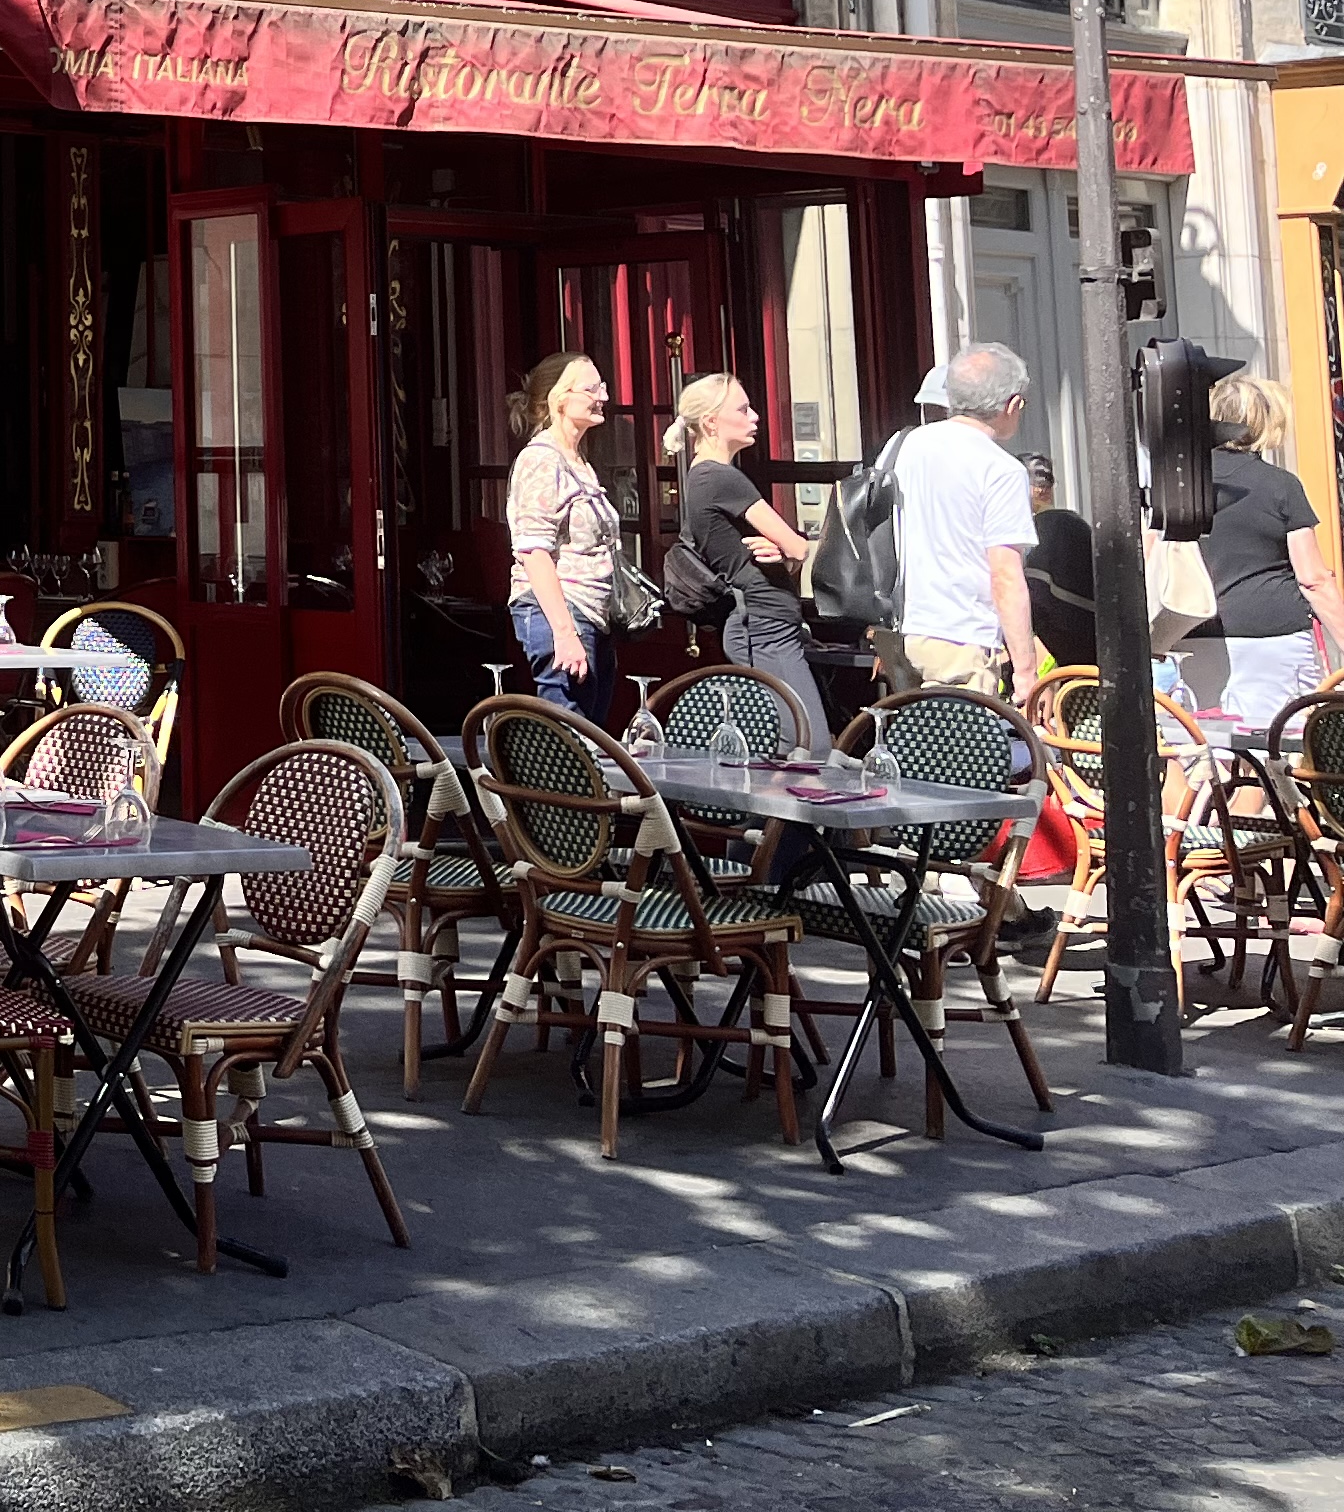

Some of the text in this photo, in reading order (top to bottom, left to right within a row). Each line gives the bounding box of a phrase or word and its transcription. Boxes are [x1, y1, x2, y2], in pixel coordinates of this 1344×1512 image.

[132, 52, 249, 86] ITALIANA
[342, 29, 603, 109] Ristorante
[631, 52, 771, 121] Terra
[800, 64, 927, 131] Nera
[994, 114, 1015, 138] 01
